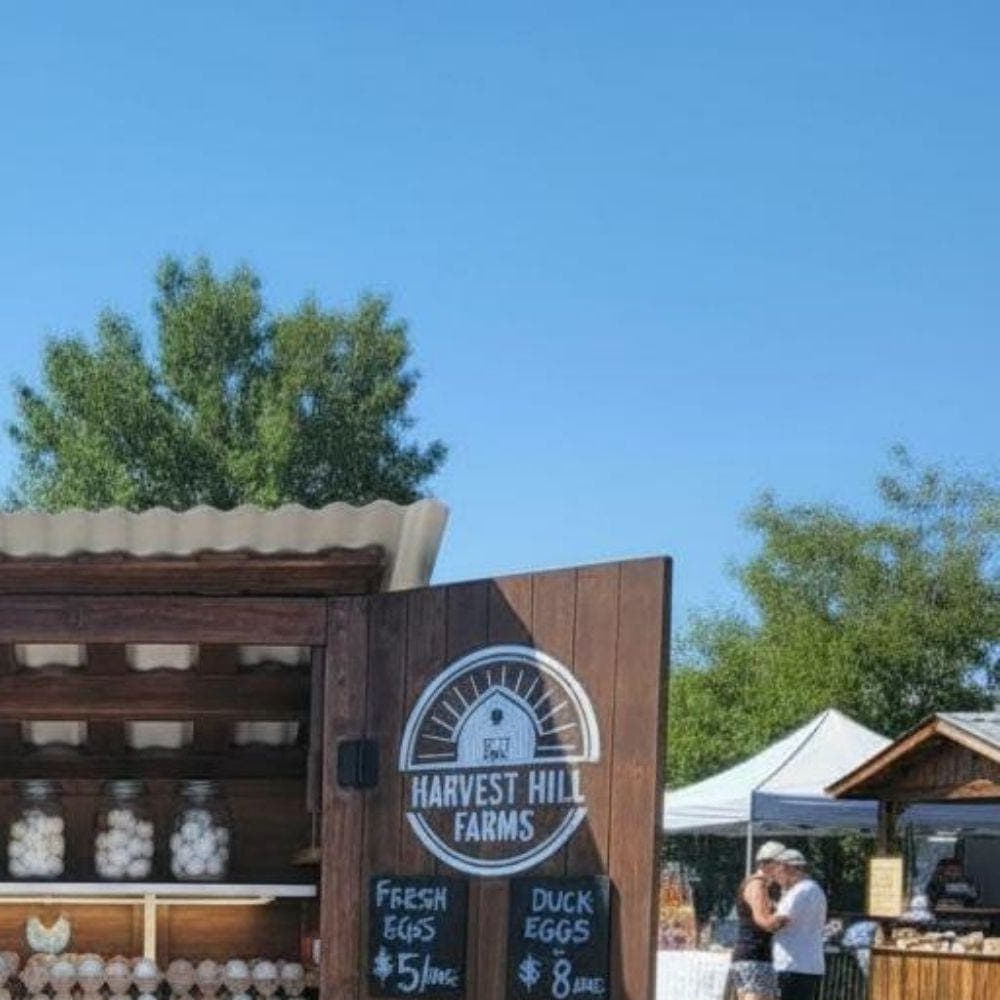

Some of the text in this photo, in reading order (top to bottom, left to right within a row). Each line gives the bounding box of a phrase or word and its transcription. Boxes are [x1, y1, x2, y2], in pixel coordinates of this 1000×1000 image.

[411, 769, 586, 808] HARVEST HILL
[454, 809, 535, 842] FARMS
[376, 879, 448, 911] FRESH
[532, 888, 595, 914] DUCK
[524, 916, 590, 943] EGGS
